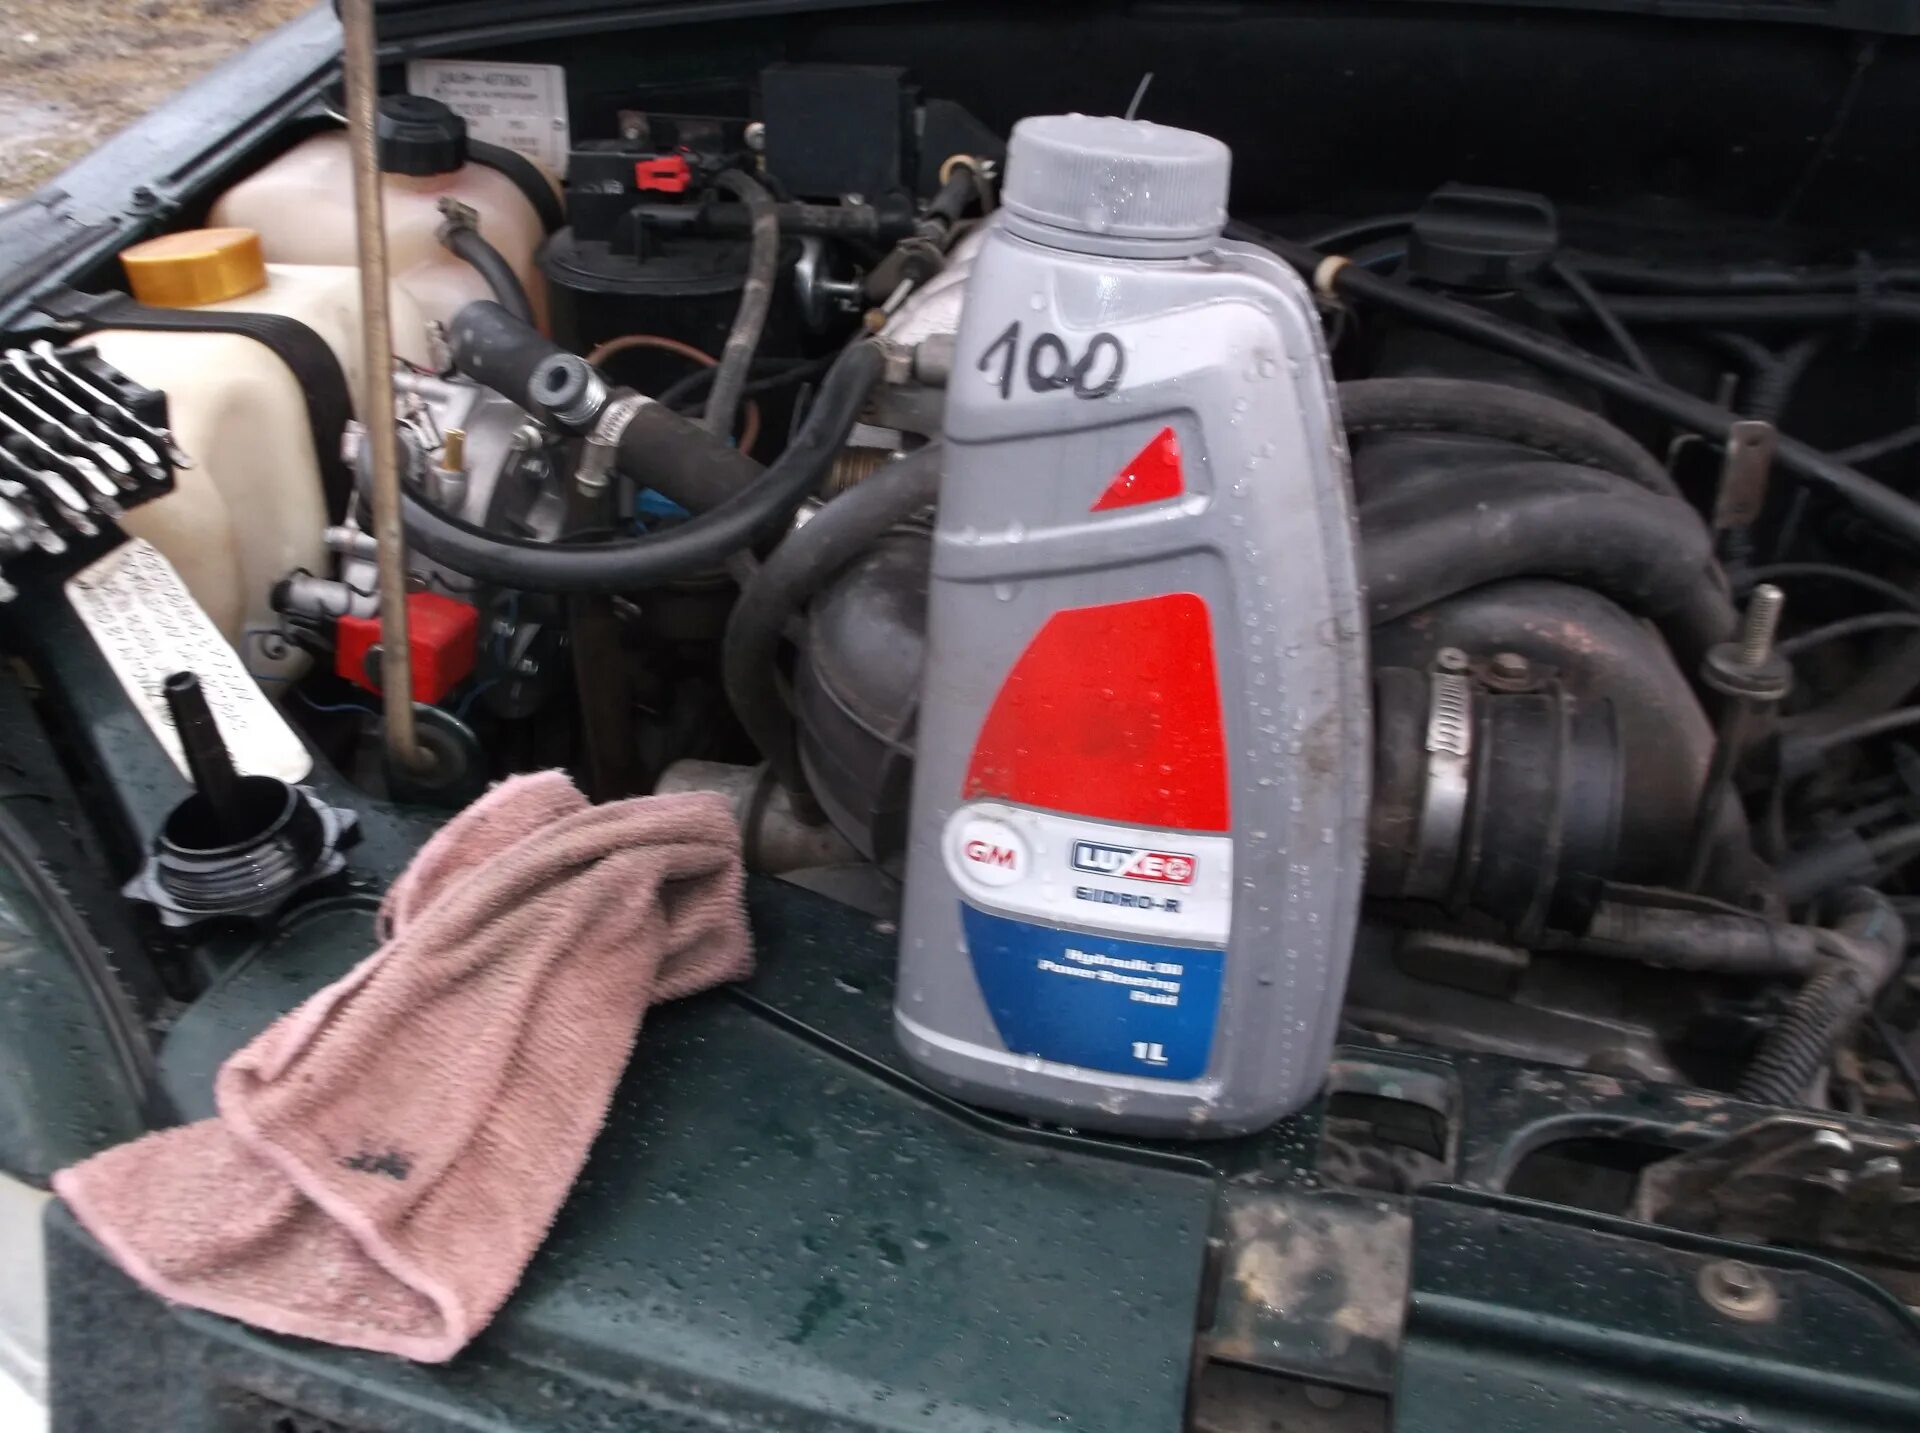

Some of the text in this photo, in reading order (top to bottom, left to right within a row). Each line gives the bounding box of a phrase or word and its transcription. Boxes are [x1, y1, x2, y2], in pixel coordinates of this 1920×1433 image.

[976, 319, 1125, 400] 100
[964, 839, 1016, 870] GM
[1038, 959, 1180, 993] Power Steering
[1132, 1042, 1168, 1063] 1L
